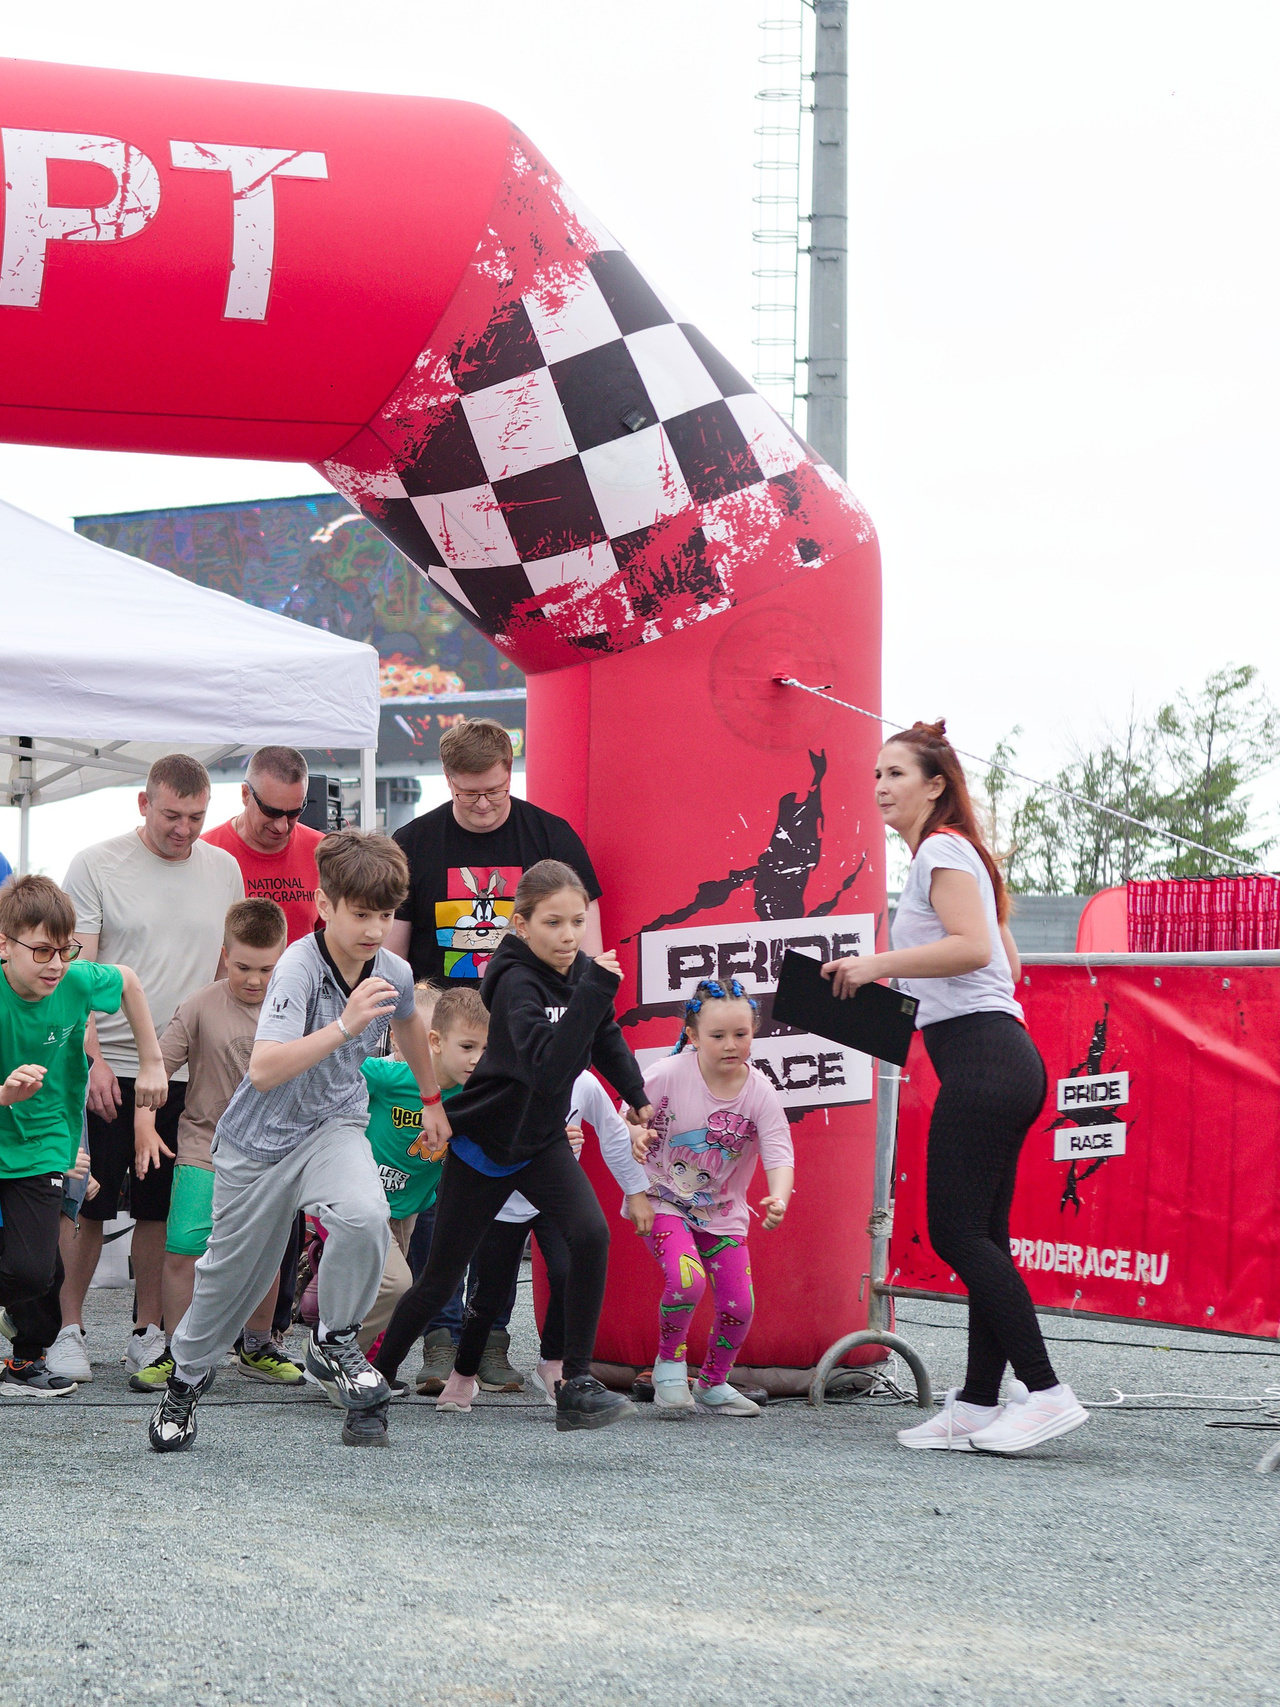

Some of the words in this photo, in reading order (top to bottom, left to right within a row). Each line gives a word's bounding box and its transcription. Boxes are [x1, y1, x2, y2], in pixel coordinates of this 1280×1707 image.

[247, 878, 304, 890] NATIONAL
[751, 1051, 847, 1091] ACE
[1063, 1080, 1121, 1105] PRIDE
[392, 1106, 424, 1128] yea
[1070, 1133, 1114, 1151] RACE
[380, 1166, 407, 1181] LET'S
[1009, 1237, 1170, 1286] PRIDERACE.RU
